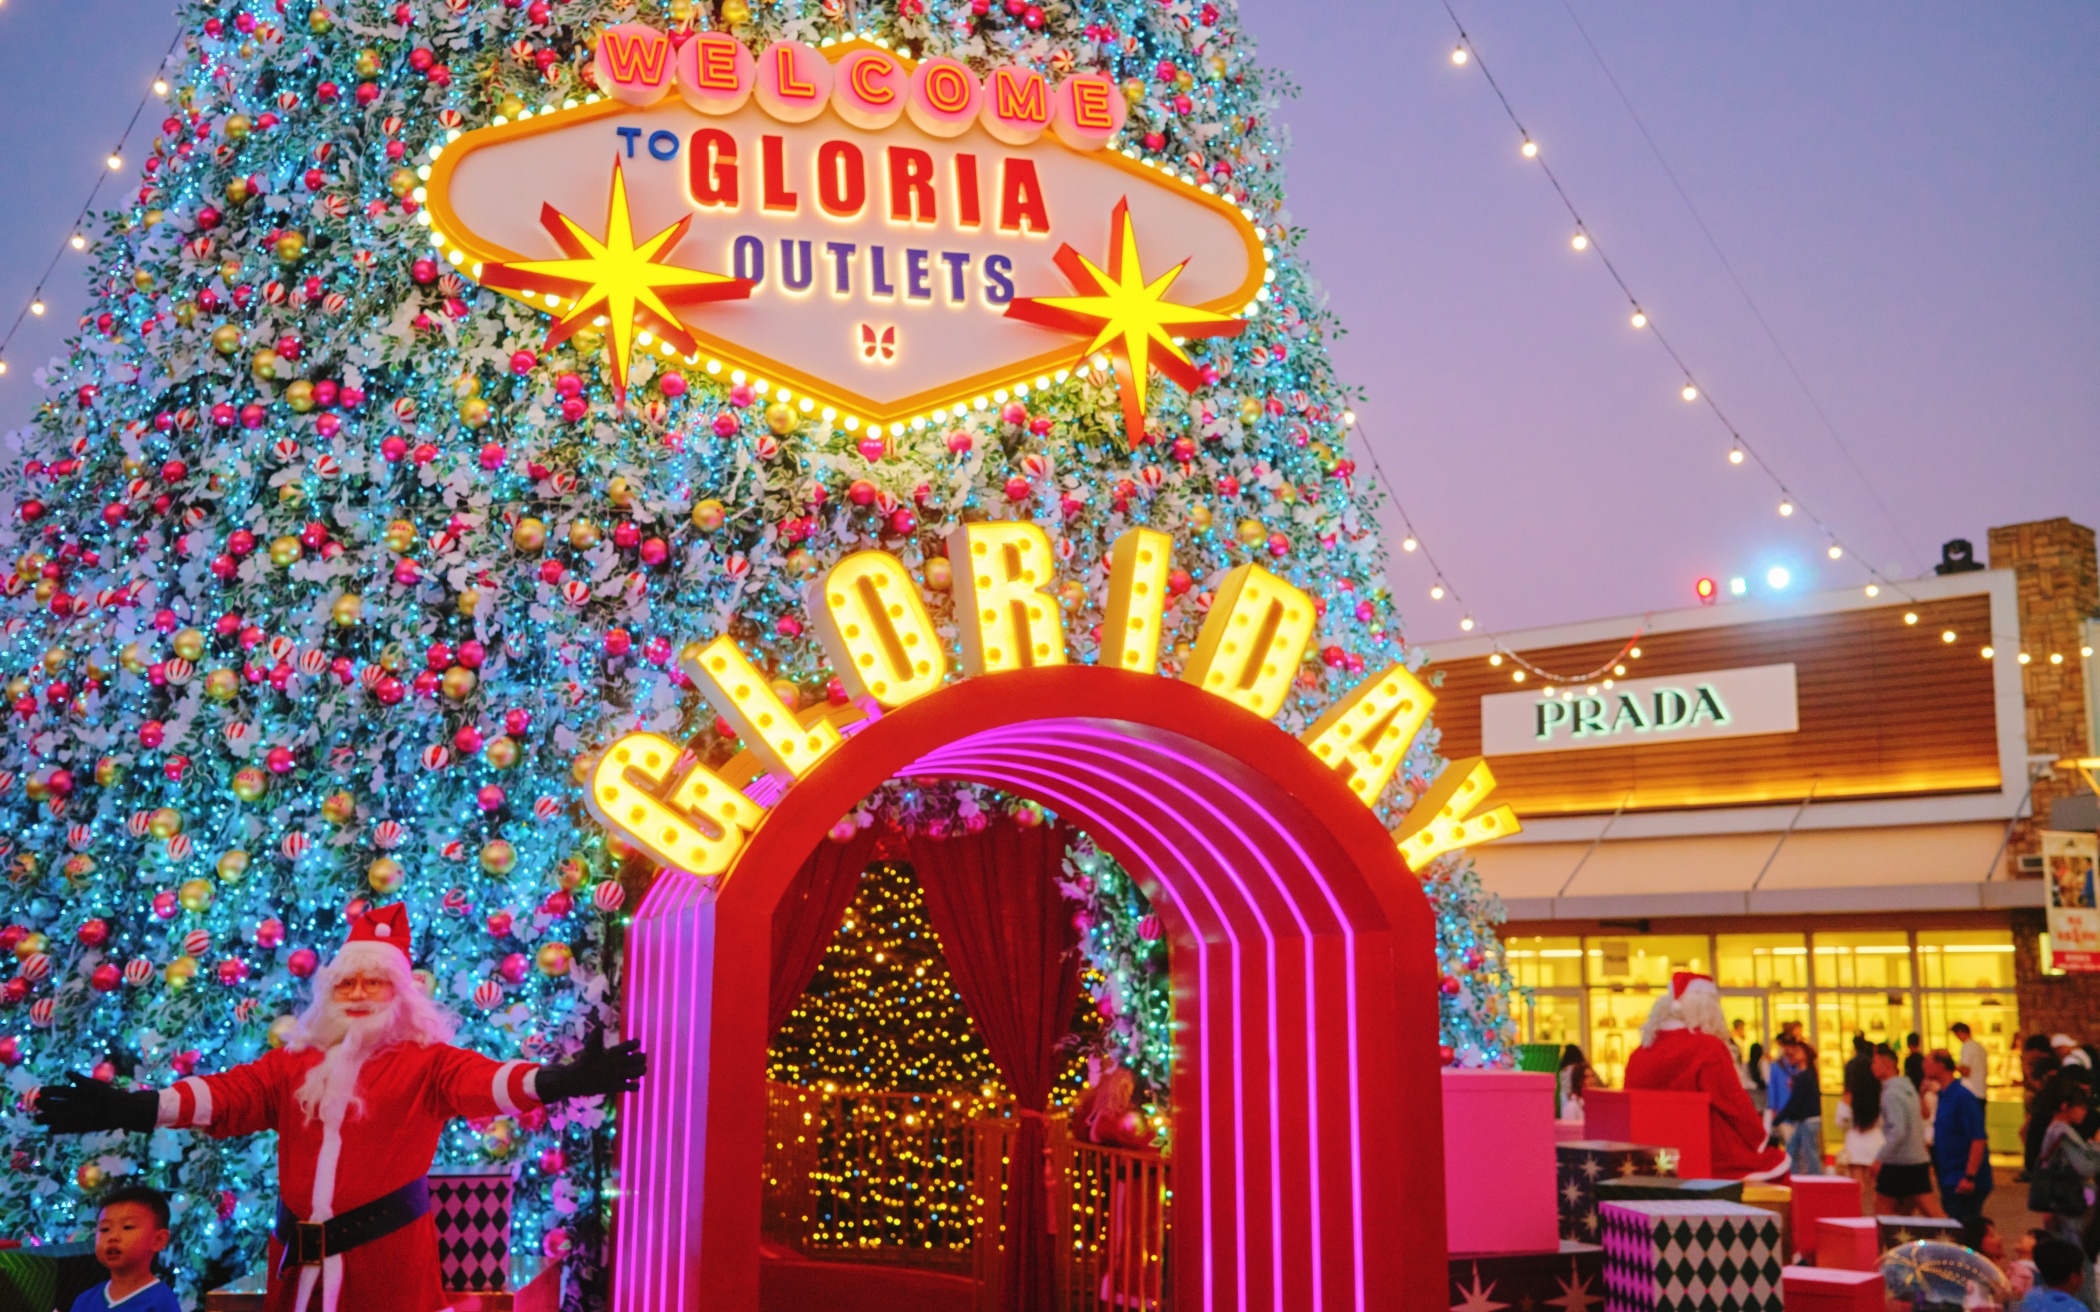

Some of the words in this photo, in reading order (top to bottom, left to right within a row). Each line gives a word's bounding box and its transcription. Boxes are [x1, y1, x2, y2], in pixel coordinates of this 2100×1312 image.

[602, 31, 1113, 129] WELCOME
[616, 126, 680, 161] TO
[689, 127, 1051, 234] GLORIA
[733, 234, 1016, 306] OUTLETS
[585, 520, 1523, 876] GLORIDAY
[1535, 687, 1727, 737] PRADA
